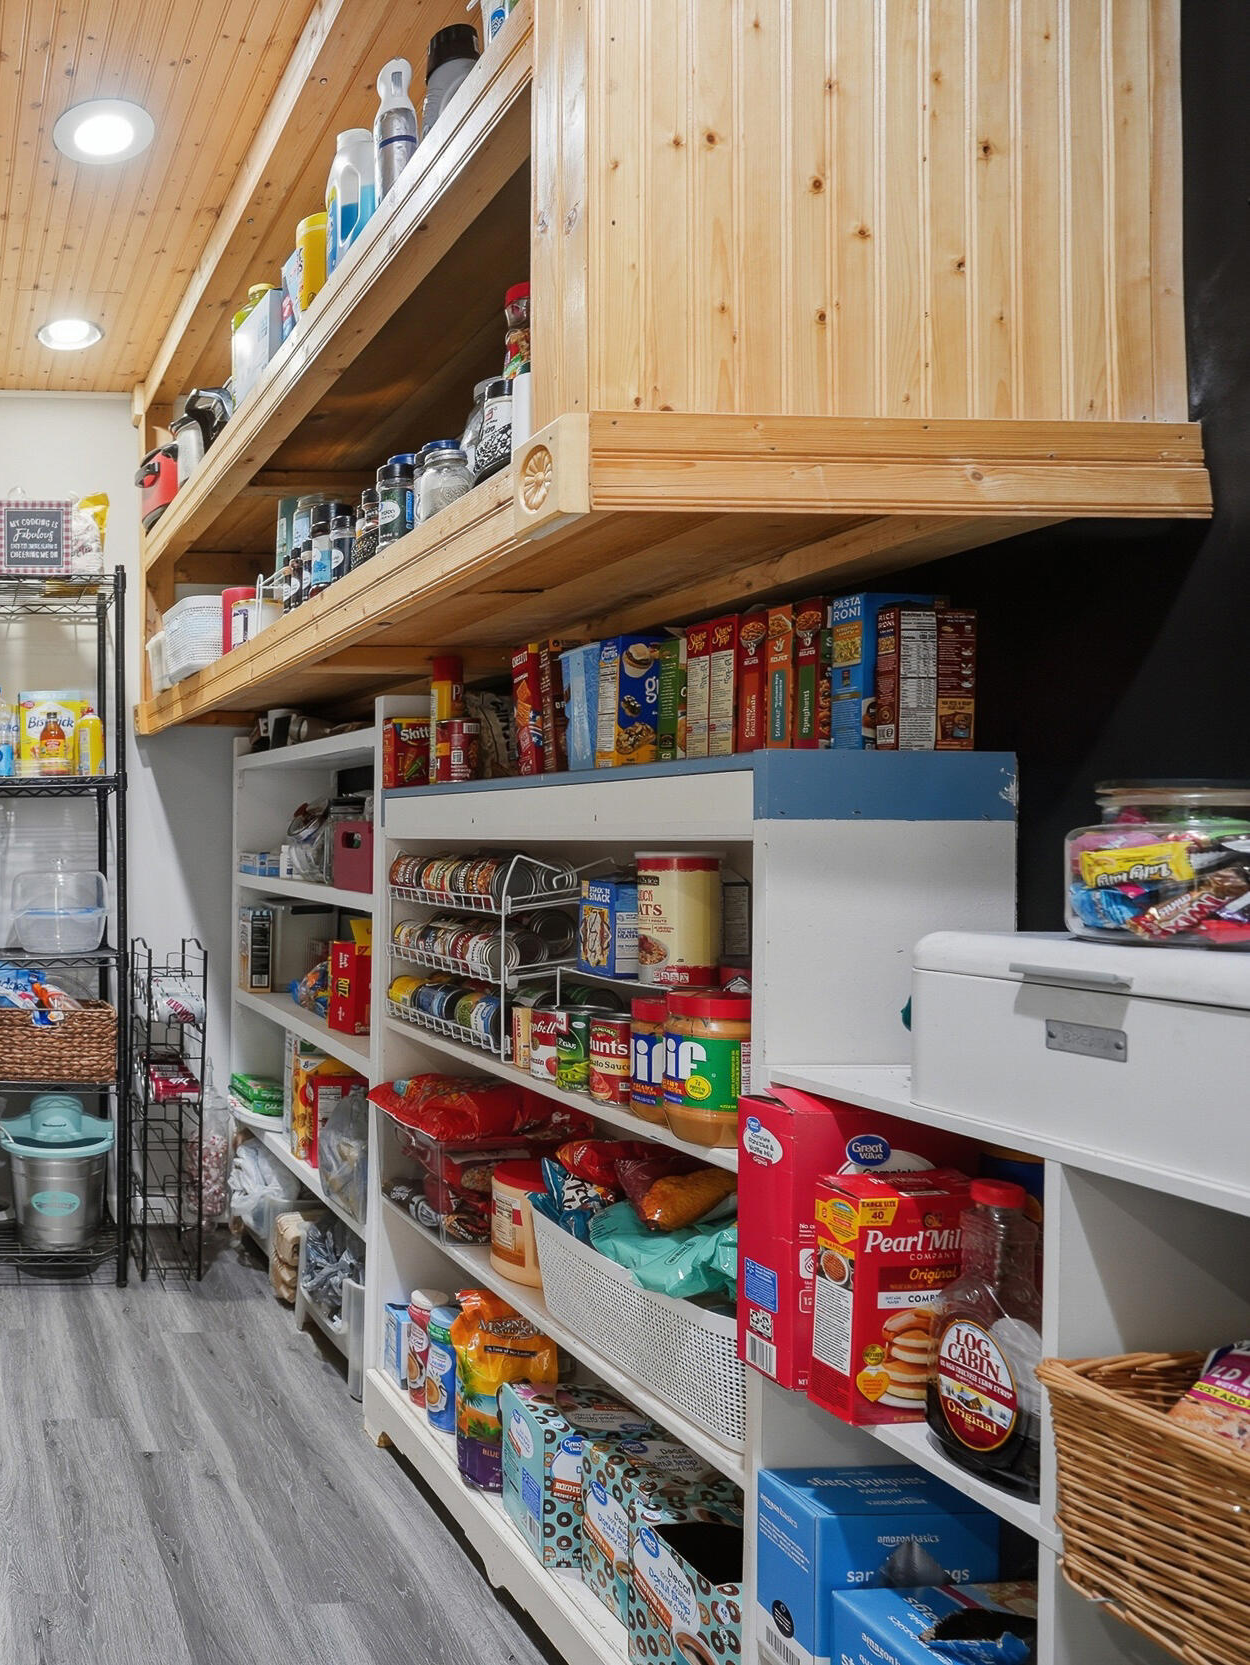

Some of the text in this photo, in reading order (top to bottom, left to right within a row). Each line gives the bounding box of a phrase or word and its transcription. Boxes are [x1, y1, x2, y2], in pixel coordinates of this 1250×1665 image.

[21, 518, 50, 527] COOKING
[13, 528, 54, 542] Fabulous
[833, 596, 861, 610] PASTA
[833, 606, 861, 621] RONI
[878, 612, 895, 620] RICE
[28, 716, 74, 728] Bisick
[338, 977, 350, 998] RITZ
[852, 1142, 883, 1153] Great
[859, 1152, 883, 1160] Value
[872, 1211, 884, 1220] 40
[864, 1230, 924, 1253] Pearl
[909, 1253, 957, 1261] COMPANY
[909, 1268, 956, 1283] Original
[955, 1327, 990, 1358] LOG
[948, 1342, 1001, 1382] CABIN
[1221, 1393, 1246, 1406] ADD
[947, 1400, 998, 1436] Original
[482, 1448, 499, 1459] BLUE
[877, 1533, 940, 1547] amazonbasics
[667, 1566, 691, 1596] Decaf
